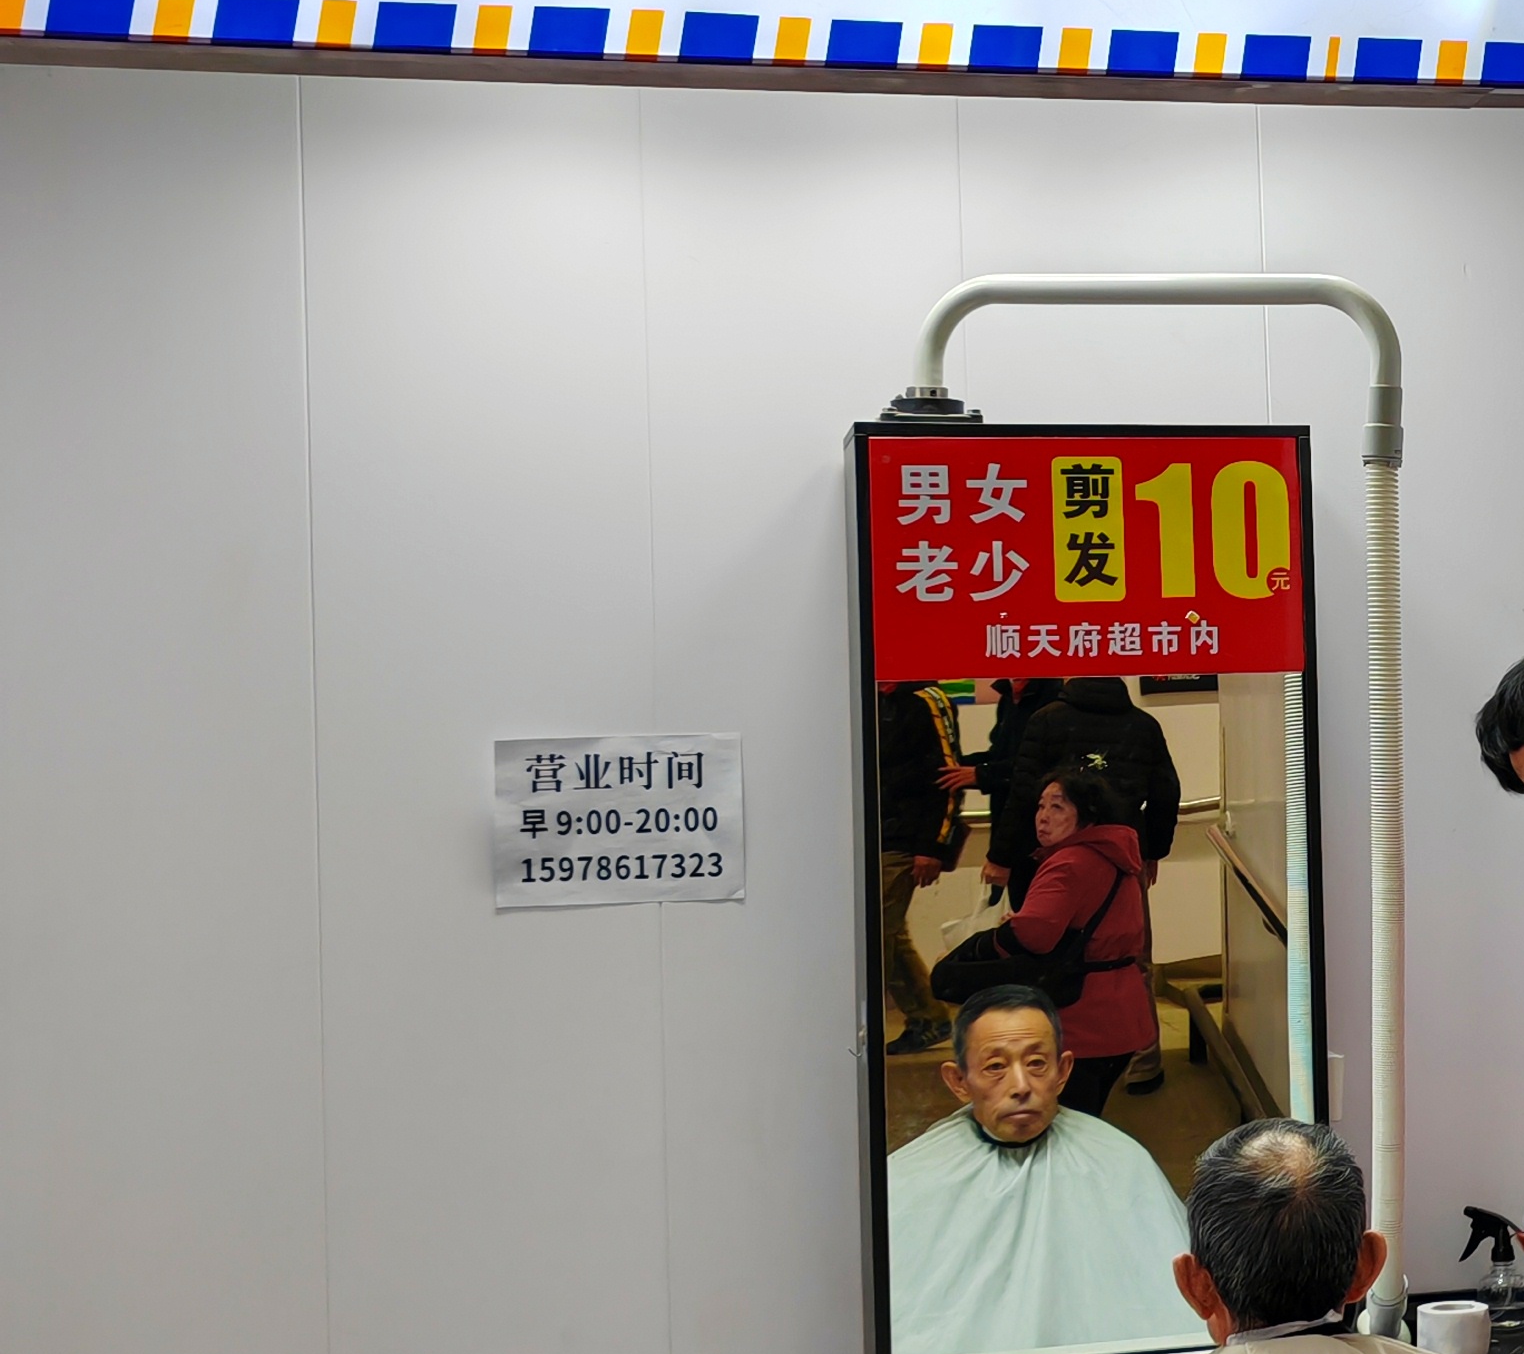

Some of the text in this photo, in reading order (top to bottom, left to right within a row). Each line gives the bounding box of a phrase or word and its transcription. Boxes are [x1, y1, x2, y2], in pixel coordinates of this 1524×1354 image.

[896, 463, 1028, 525] 男女
[1060, 463, 1119, 588] 剪发
[895, 540, 1030, 602] 老少
[984, 619, 1220, 659] 顺天府超市内
[524, 751, 705, 794] 营业时间
[520, 852, 723, 883] 15978617323
